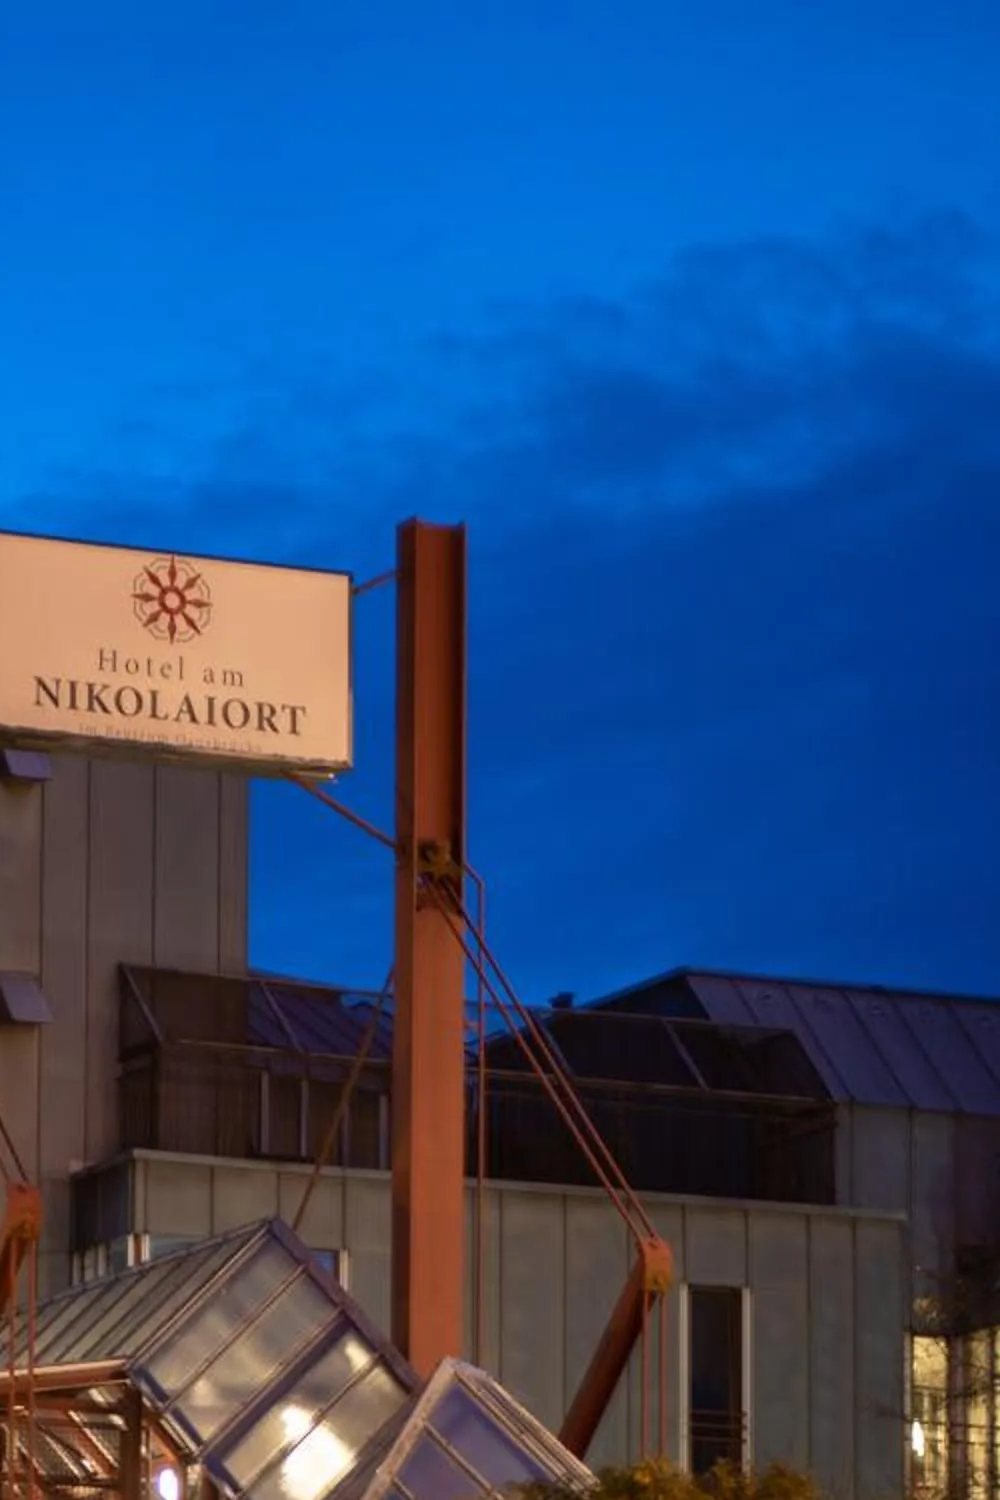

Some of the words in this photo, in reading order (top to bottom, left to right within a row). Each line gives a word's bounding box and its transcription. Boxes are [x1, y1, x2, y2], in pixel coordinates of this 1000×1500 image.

[98, 646, 185, 680] Hotel
[202, 668, 245, 688] am
[32, 675, 307, 736] NIKOLAIORT
